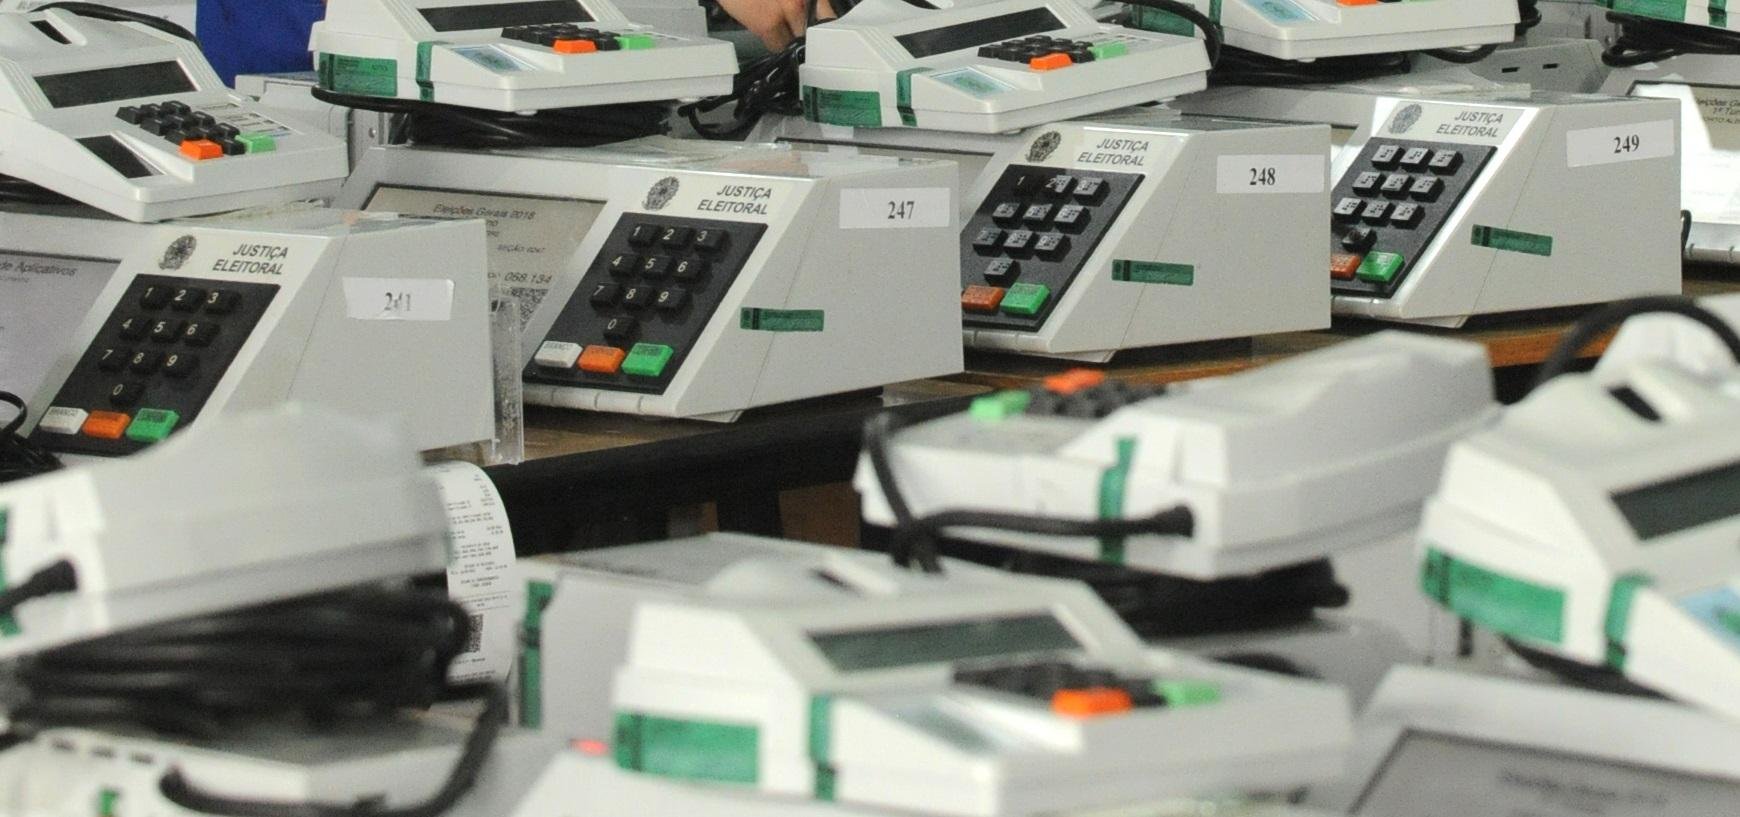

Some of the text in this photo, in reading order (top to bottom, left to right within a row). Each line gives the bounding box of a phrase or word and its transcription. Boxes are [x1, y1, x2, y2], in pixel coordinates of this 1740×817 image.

[1455, 111, 1504, 125] JUSTIÇA
[1436, 124, 1499, 137] ELEITORAL
[1097, 138, 1149, 153] JUSTIÇA
[1613, 134, 1640, 154] 249
[1077, 151, 1145, 166] ELEITORAL
[1017, 175, 1026, 186] 1
[1045, 177, 1057, 188] 2
[1250, 168, 1276, 186] 248
[716, 184, 772, 200] JUSTIÇA
[696, 199, 769, 215] ELEITORAL
[887, 201, 915, 220] 247
[633, 226, 708, 242] 1 2 3
[232, 244, 288, 260] JUSTIÇA
[212, 258, 284, 275] ELEITORAL
[612, 255, 689, 273] 4 5 6
[144, 286, 219, 304] 1 2 3
[593, 285, 670, 303] 7 8 9
[122, 318, 198, 336] 4 5 6
[607, 318, 617, 330] 0
[102, 348, 179, 367] 7 8 9
[113, 383, 124, 396] 0
